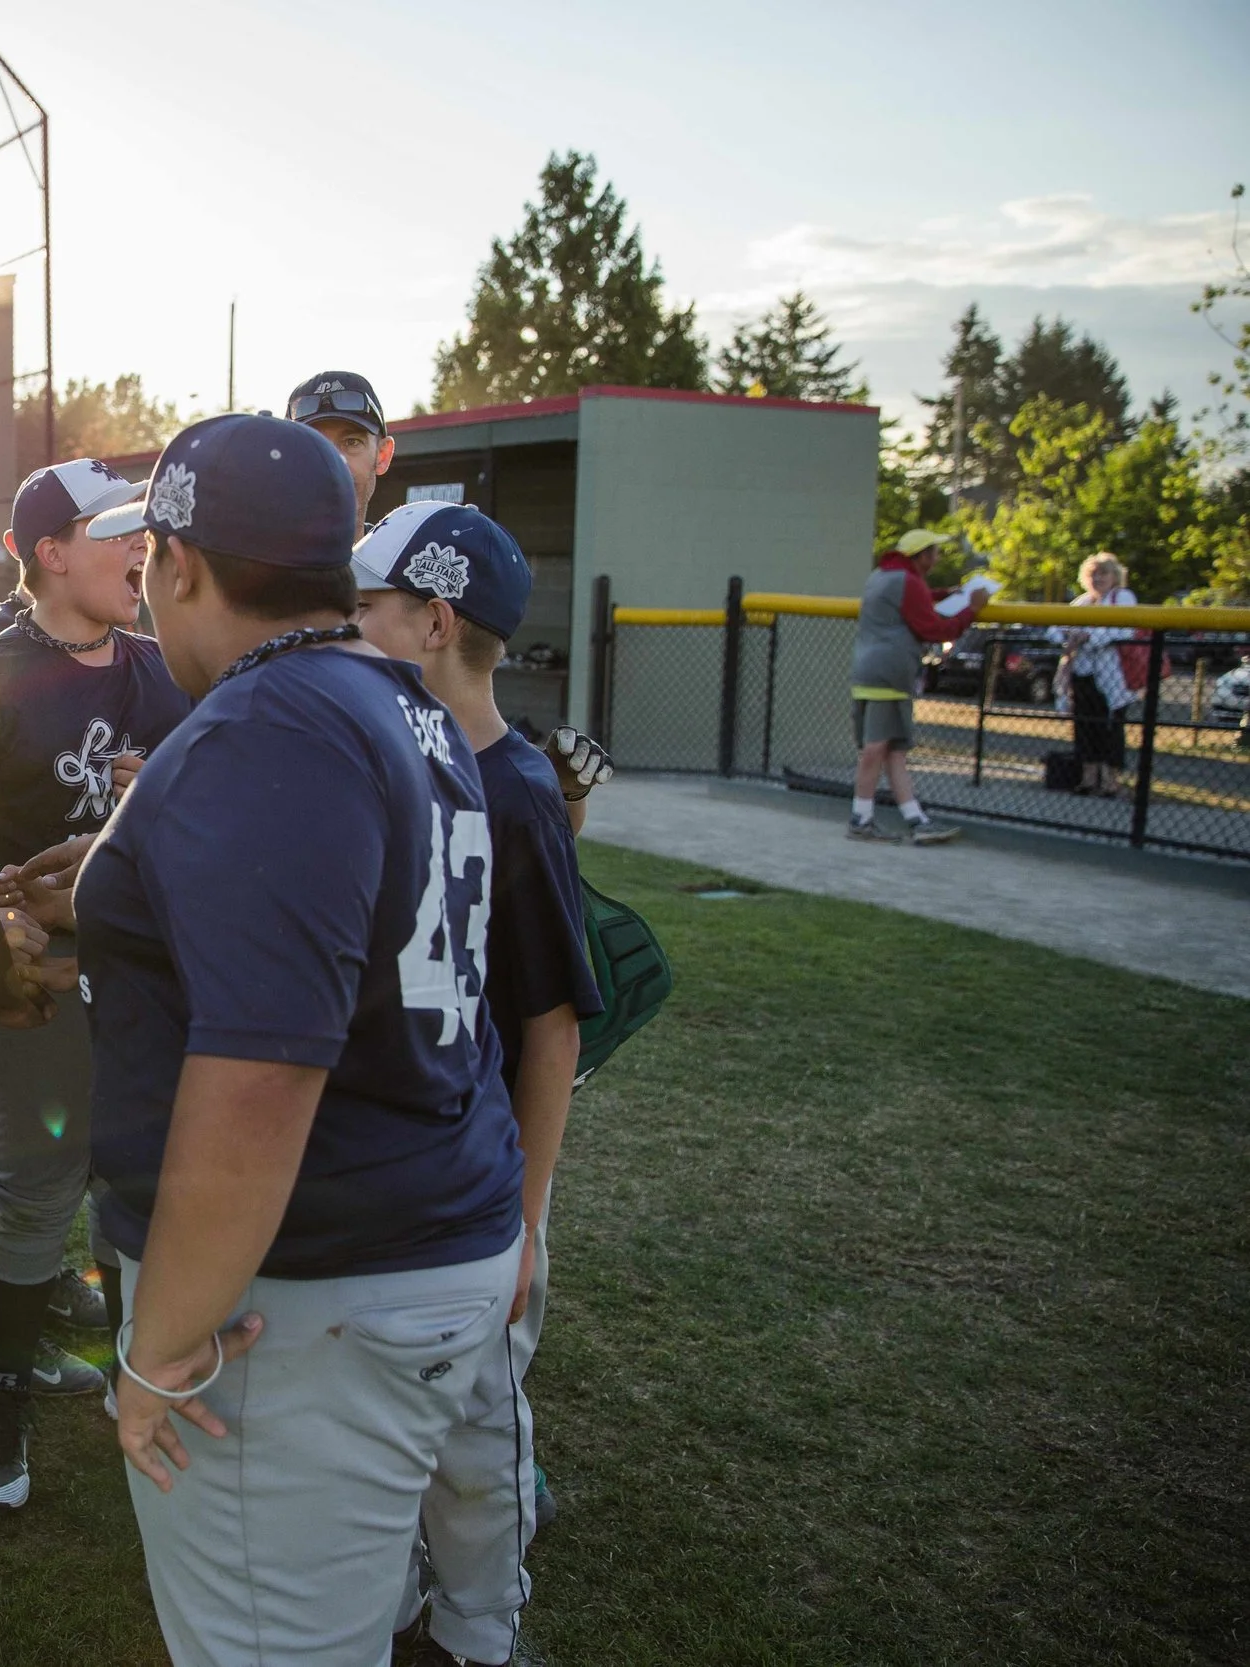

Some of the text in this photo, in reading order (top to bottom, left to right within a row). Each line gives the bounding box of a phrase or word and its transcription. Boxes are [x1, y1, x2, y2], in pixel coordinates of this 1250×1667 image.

[420, 560, 435, 572] ALL
[435, 564, 459, 583] STARS
[398, 801, 493, 1046] 43
